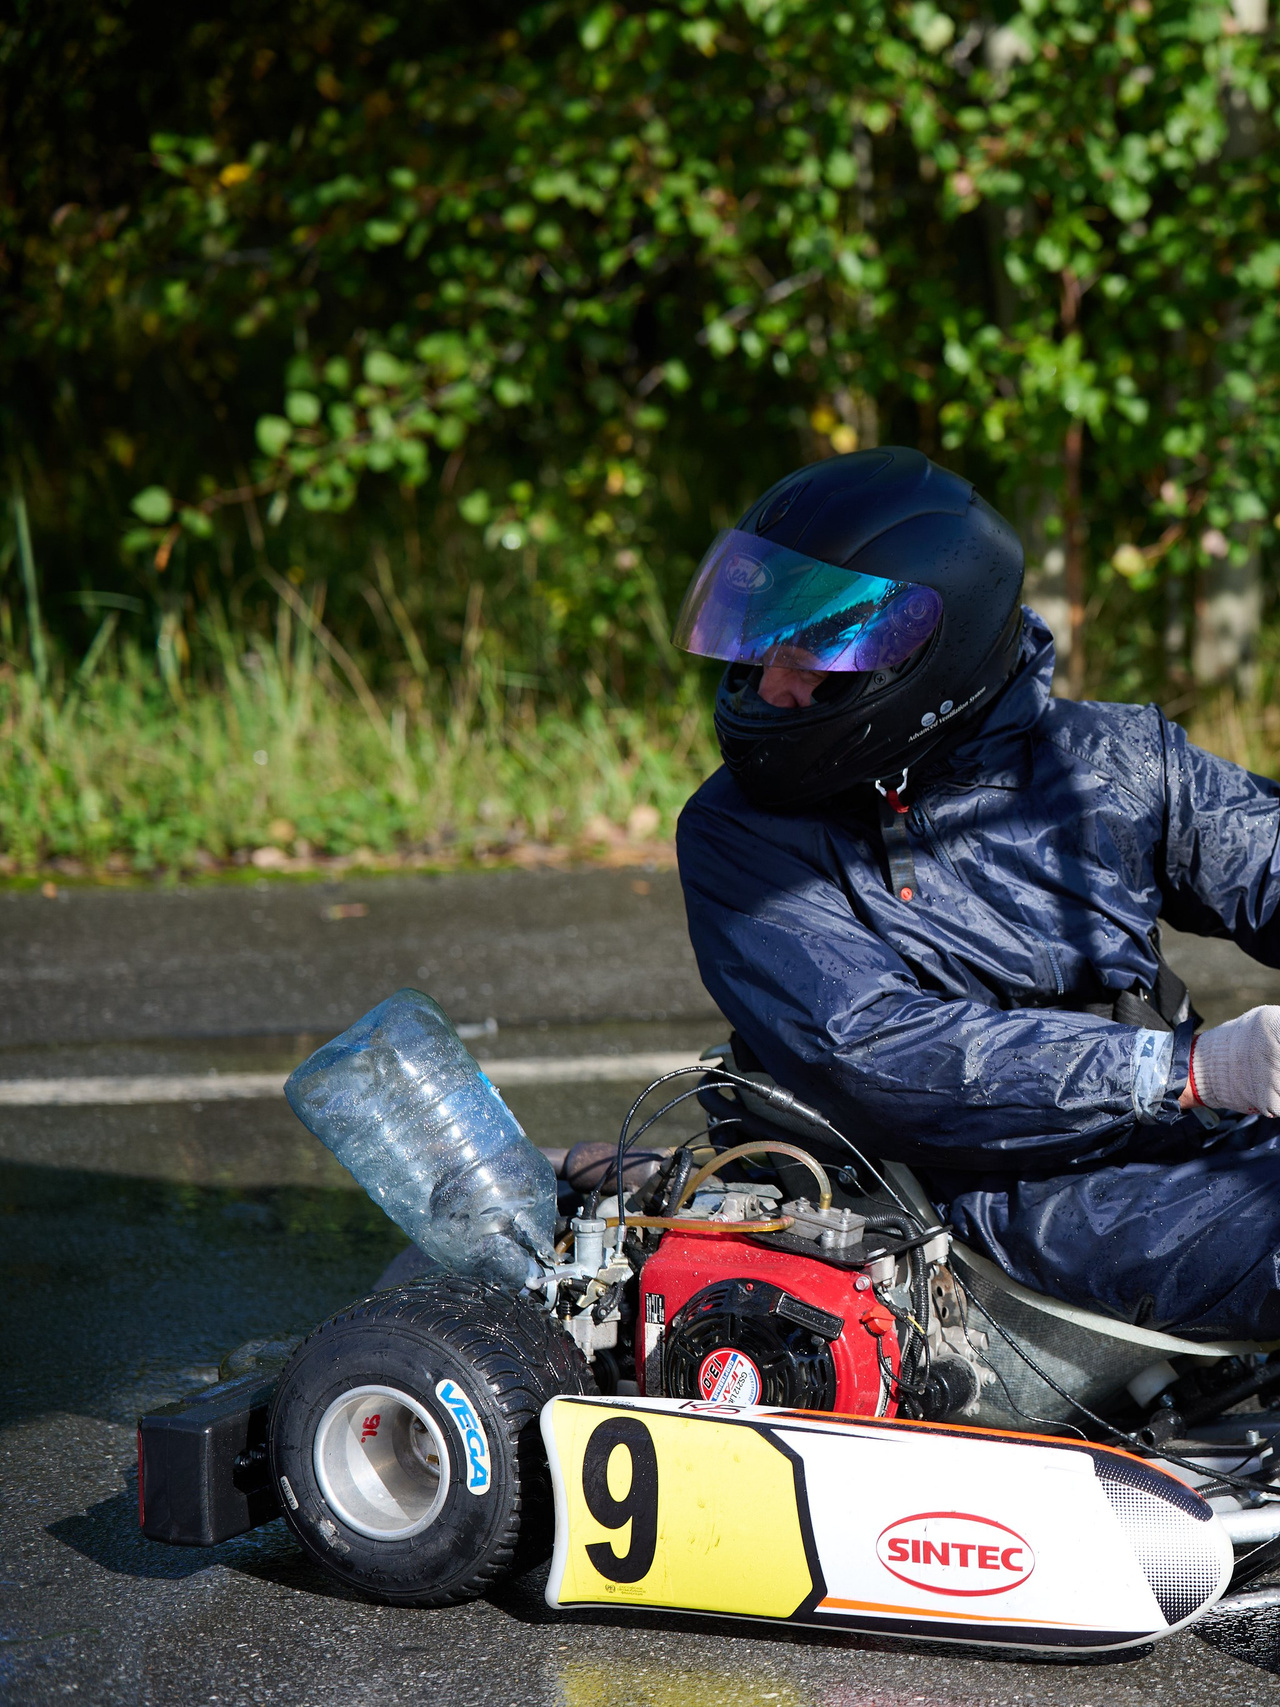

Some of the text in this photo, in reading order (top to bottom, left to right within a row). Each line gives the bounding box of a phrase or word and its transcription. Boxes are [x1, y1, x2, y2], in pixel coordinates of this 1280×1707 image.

[702, 1356, 724, 1391] 13.0
[732, 1371, 748, 1395] GS212
[440, 1382, 487, 1487] VEGA
[582, 1416, 658, 1584] 9
[888, 1537, 1023, 1572] SINTEC
